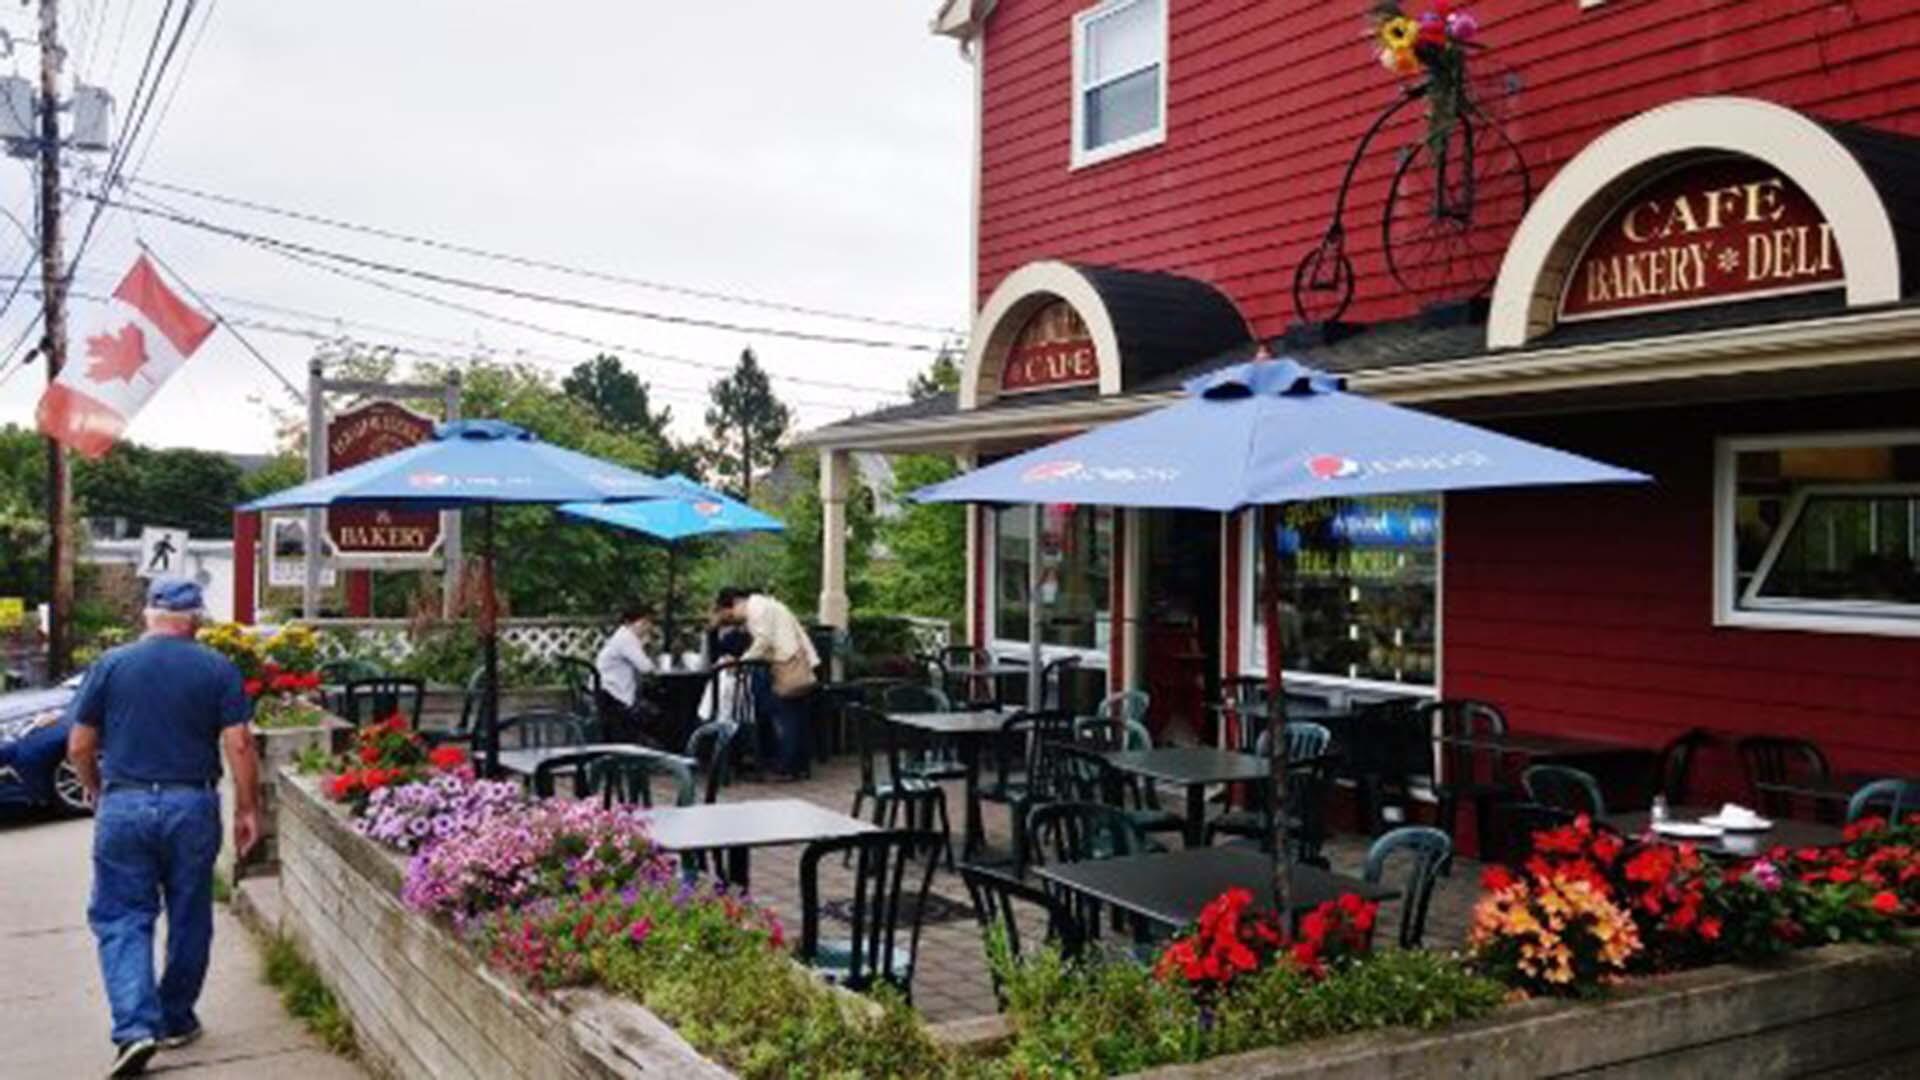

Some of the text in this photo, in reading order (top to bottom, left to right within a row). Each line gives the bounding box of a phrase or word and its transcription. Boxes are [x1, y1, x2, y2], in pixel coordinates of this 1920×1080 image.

[1622, 178, 1785, 243] CAFE
[1588, 223, 1834, 302] BAKERY DELI
[339, 526, 426, 547] BAKERY
